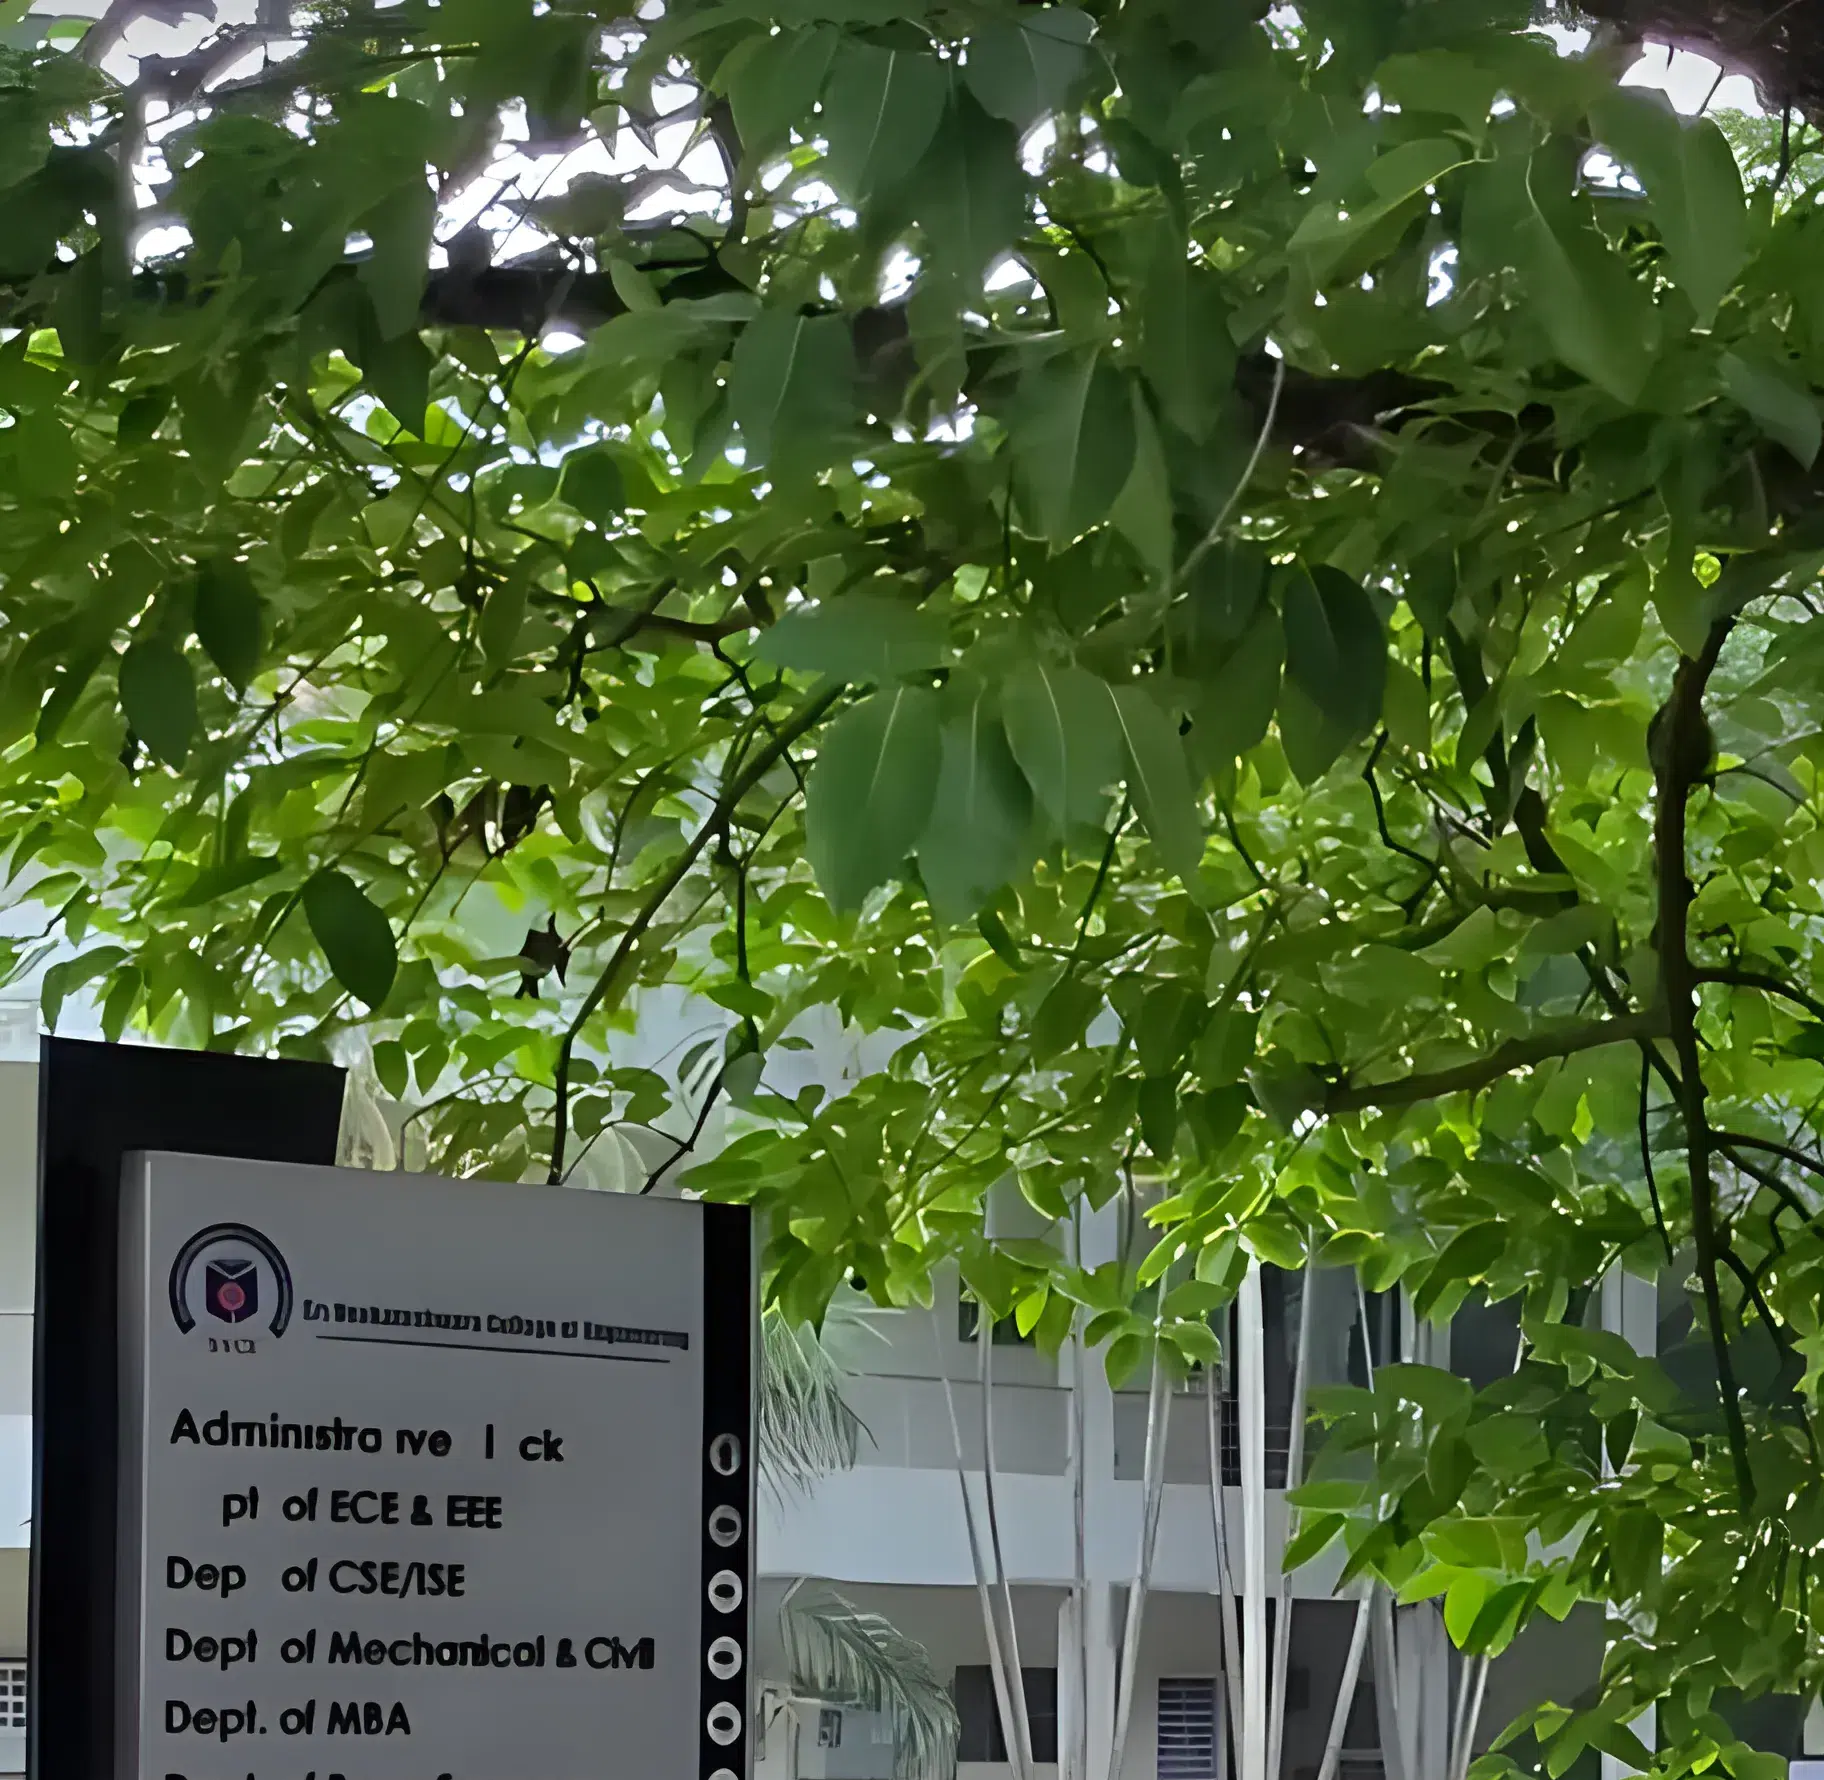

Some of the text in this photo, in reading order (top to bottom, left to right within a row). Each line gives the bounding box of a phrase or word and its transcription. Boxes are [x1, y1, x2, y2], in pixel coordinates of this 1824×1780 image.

[281, 1486, 319, 1522] of
[330, 1489, 400, 1525] ECE
[410, 1494, 434, 1527] &
[446, 1494, 503, 1530] EEE
[280, 1556, 319, 1593] of
[328, 1559, 466, 1600] CSE/ISE
[279, 1627, 317, 1664] of
[327, 1630, 546, 1669] Mechanical
[555, 1637, 578, 1669] &
[164, 1698, 412, 1744] Dept. of MBA
